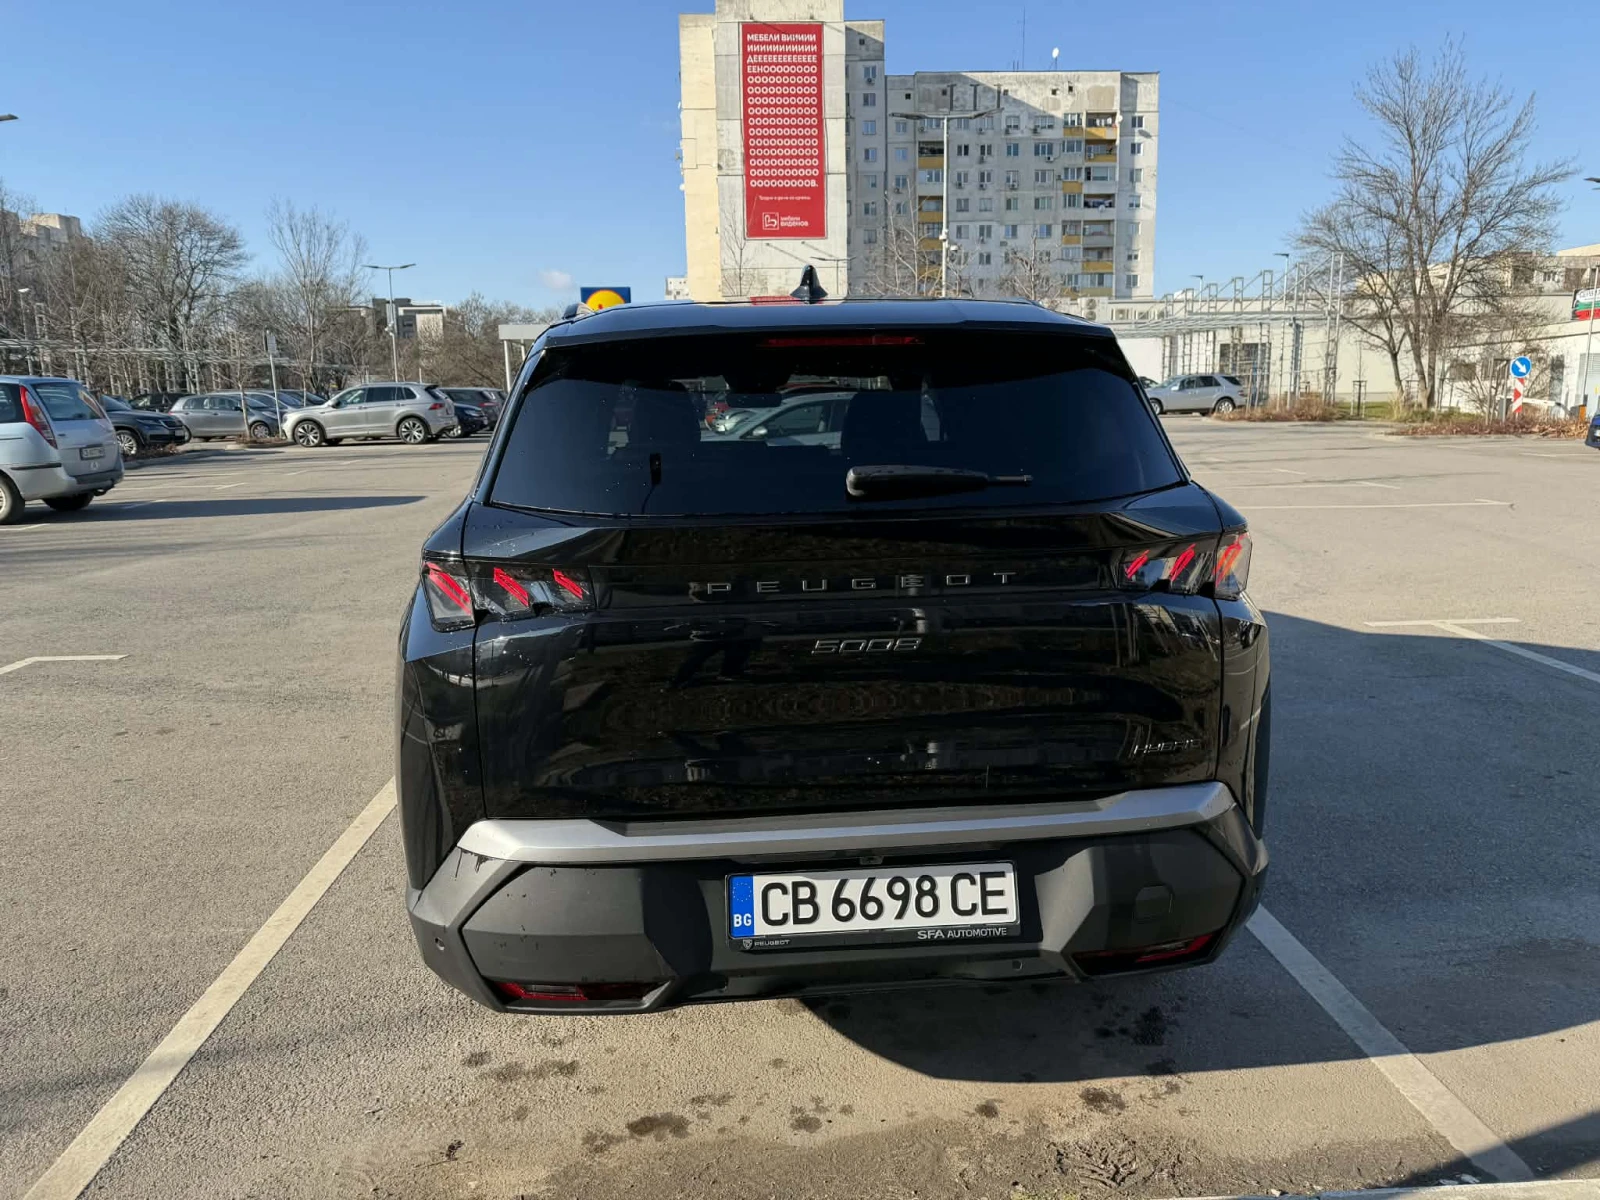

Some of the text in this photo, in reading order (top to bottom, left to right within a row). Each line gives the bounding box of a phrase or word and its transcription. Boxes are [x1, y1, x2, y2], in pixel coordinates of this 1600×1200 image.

[747, 33, 780, 42] МЕБЕЛИ
[707, 572, 1017, 594] PEUGEOT
[811, 637, 922, 655] 5008
[761, 871, 1009, 927] CB 6698 CE
[733, 913, 753, 928] BG
[917, 927, 1007, 940] SFA AUTOMOTIVE
[754, 939, 790, 947] PEUGEOT
